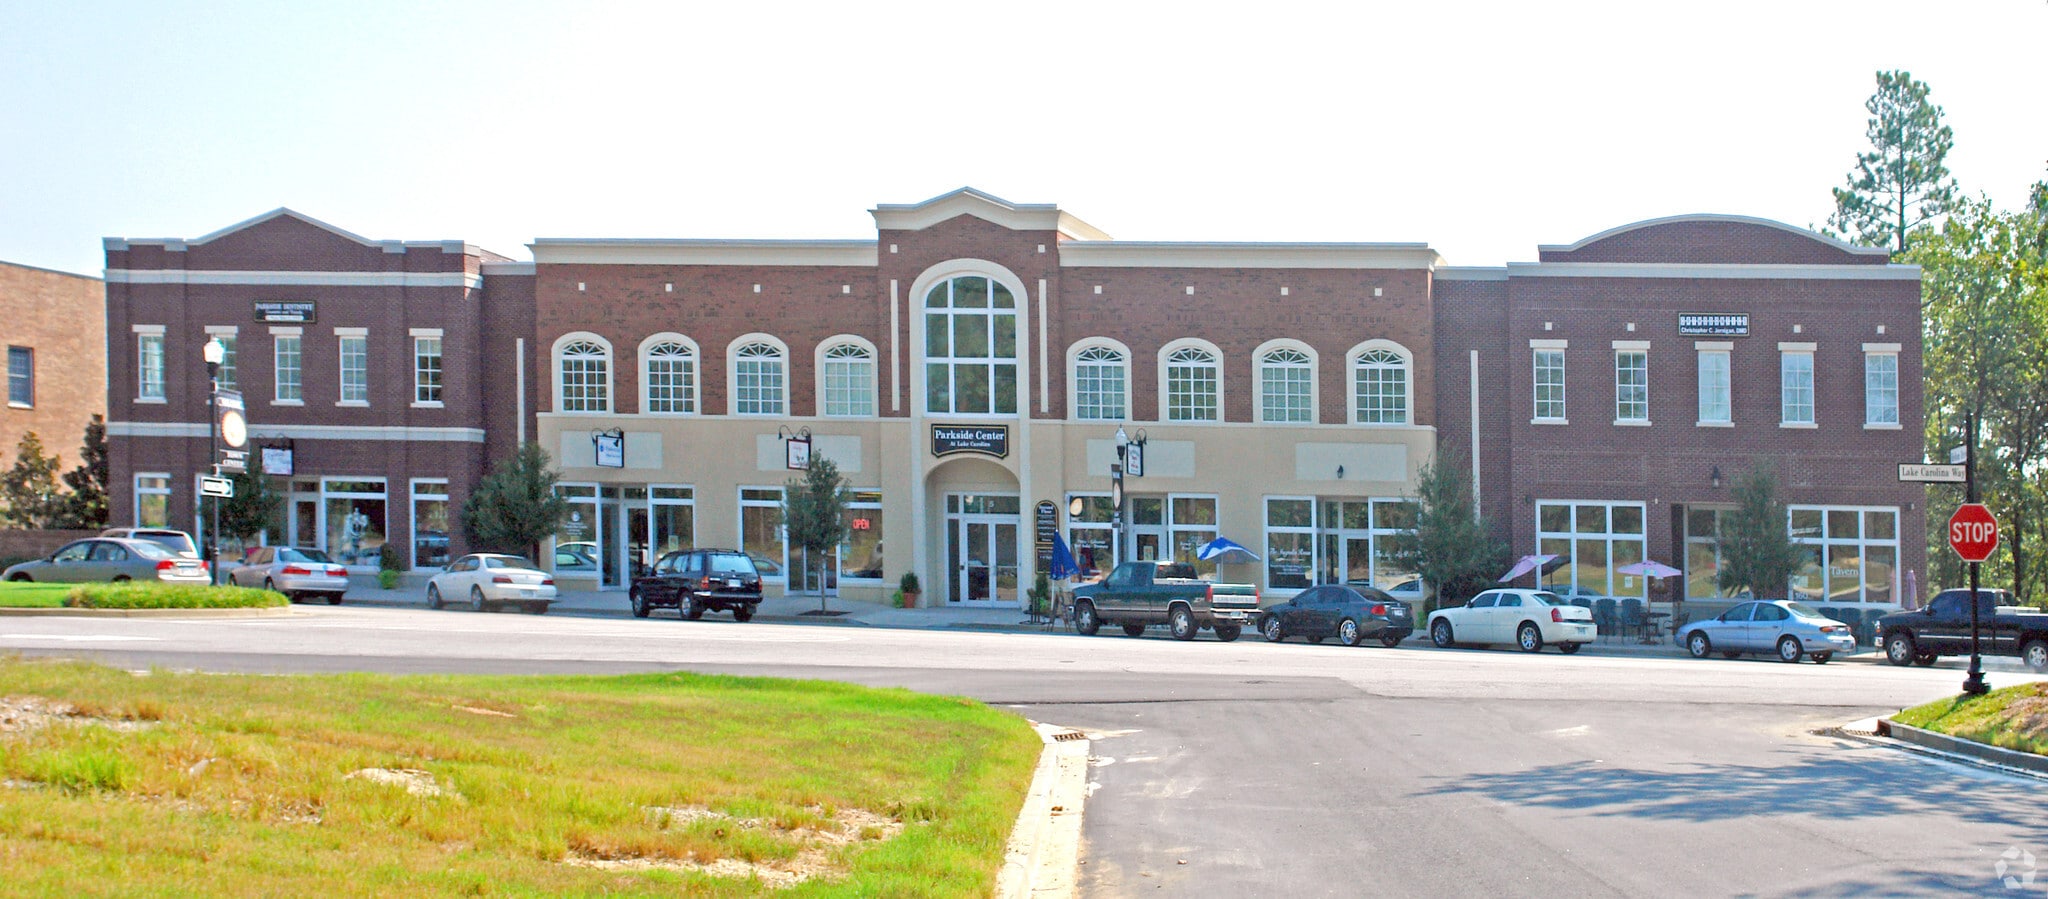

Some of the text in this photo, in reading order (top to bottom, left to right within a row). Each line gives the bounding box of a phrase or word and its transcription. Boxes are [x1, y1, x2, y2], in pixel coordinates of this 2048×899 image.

[935, 430, 1004, 440] Parkside Center
[1902, 467, 1965, 479] Lake Carolina Way
[852, 518, 870, 529] OPEN
[1952, 522, 1995, 543] STOP
[1830, 566, 1859, 576] Tavern
